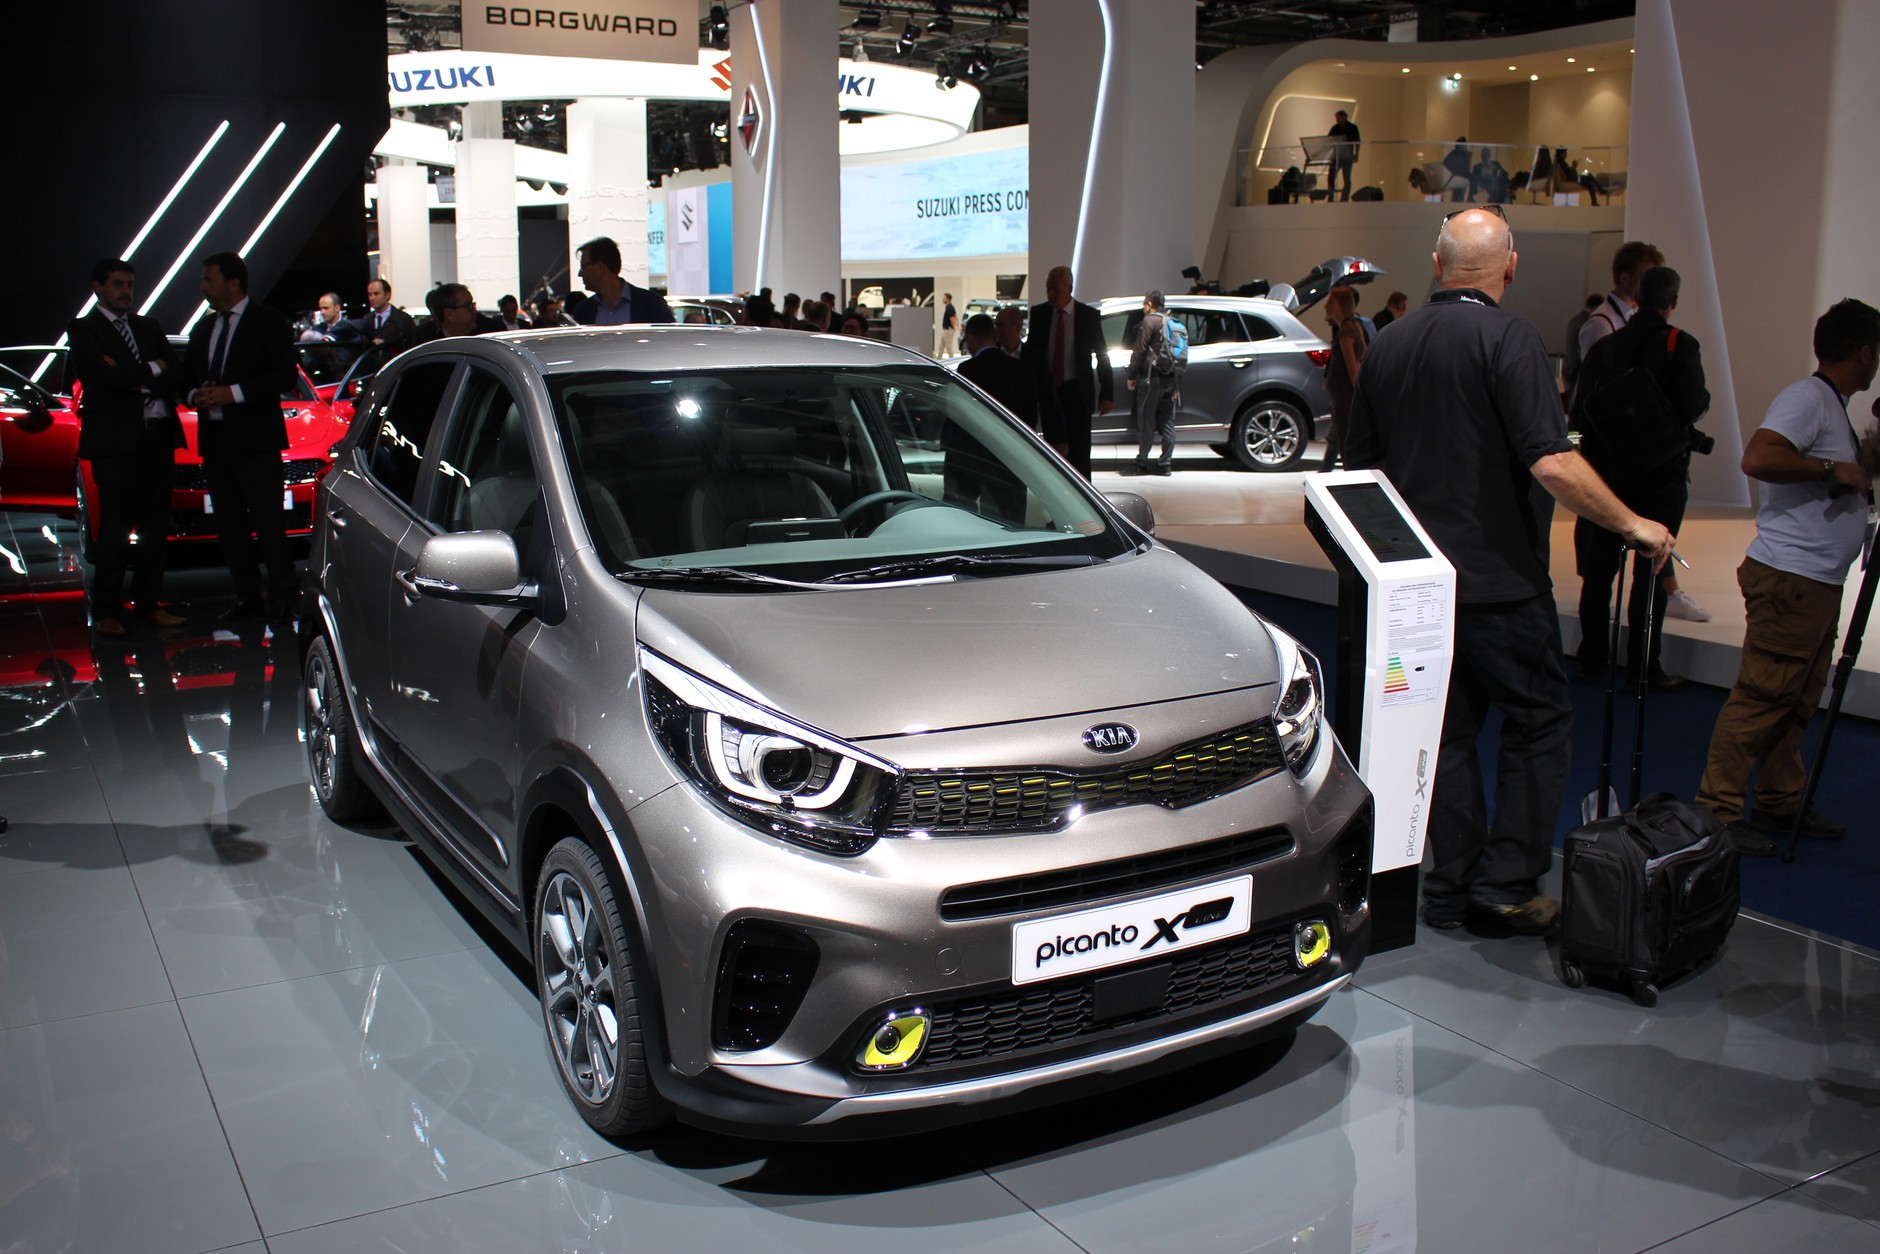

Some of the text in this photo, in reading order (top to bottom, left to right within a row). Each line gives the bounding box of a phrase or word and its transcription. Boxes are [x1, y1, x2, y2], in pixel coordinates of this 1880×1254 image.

[486, 6, 678, 36] BORGWARD
[389, 65, 495, 92] UZUKI
[917, 196, 960, 218] SUZUKI
[965, 192, 1002, 214] PRESS
[1091, 726, 1132, 748] KIA
[1405, 804, 1420, 857] picanto
[1036, 924, 1139, 968] picanto
